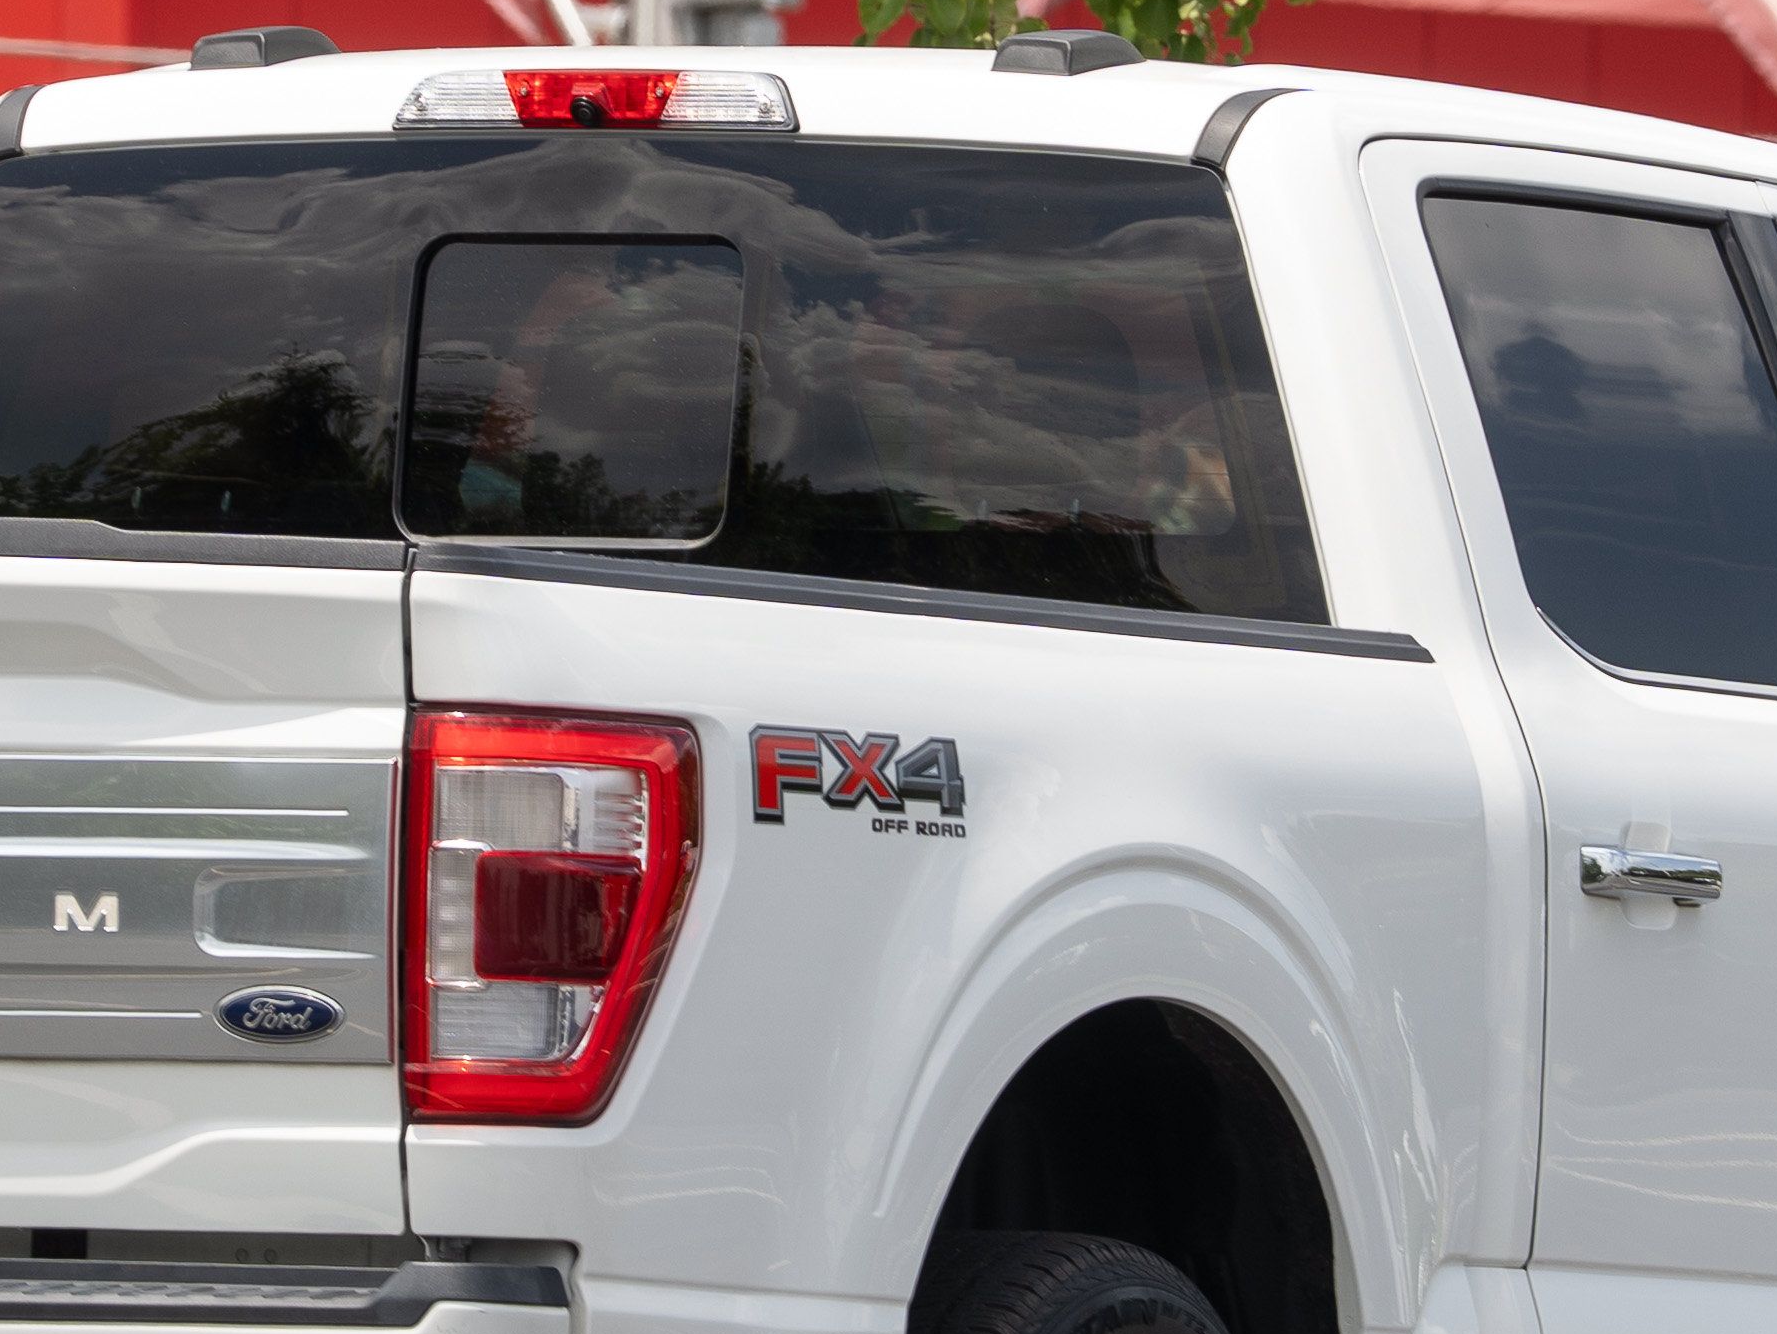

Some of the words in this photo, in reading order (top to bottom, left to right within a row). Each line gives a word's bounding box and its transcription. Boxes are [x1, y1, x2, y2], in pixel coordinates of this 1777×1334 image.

[748, 723, 967, 825] FX4
[872, 818, 909, 834] OFF
[915, 821, 966, 839] ROAD
[242, 997, 314, 1030] Ford
